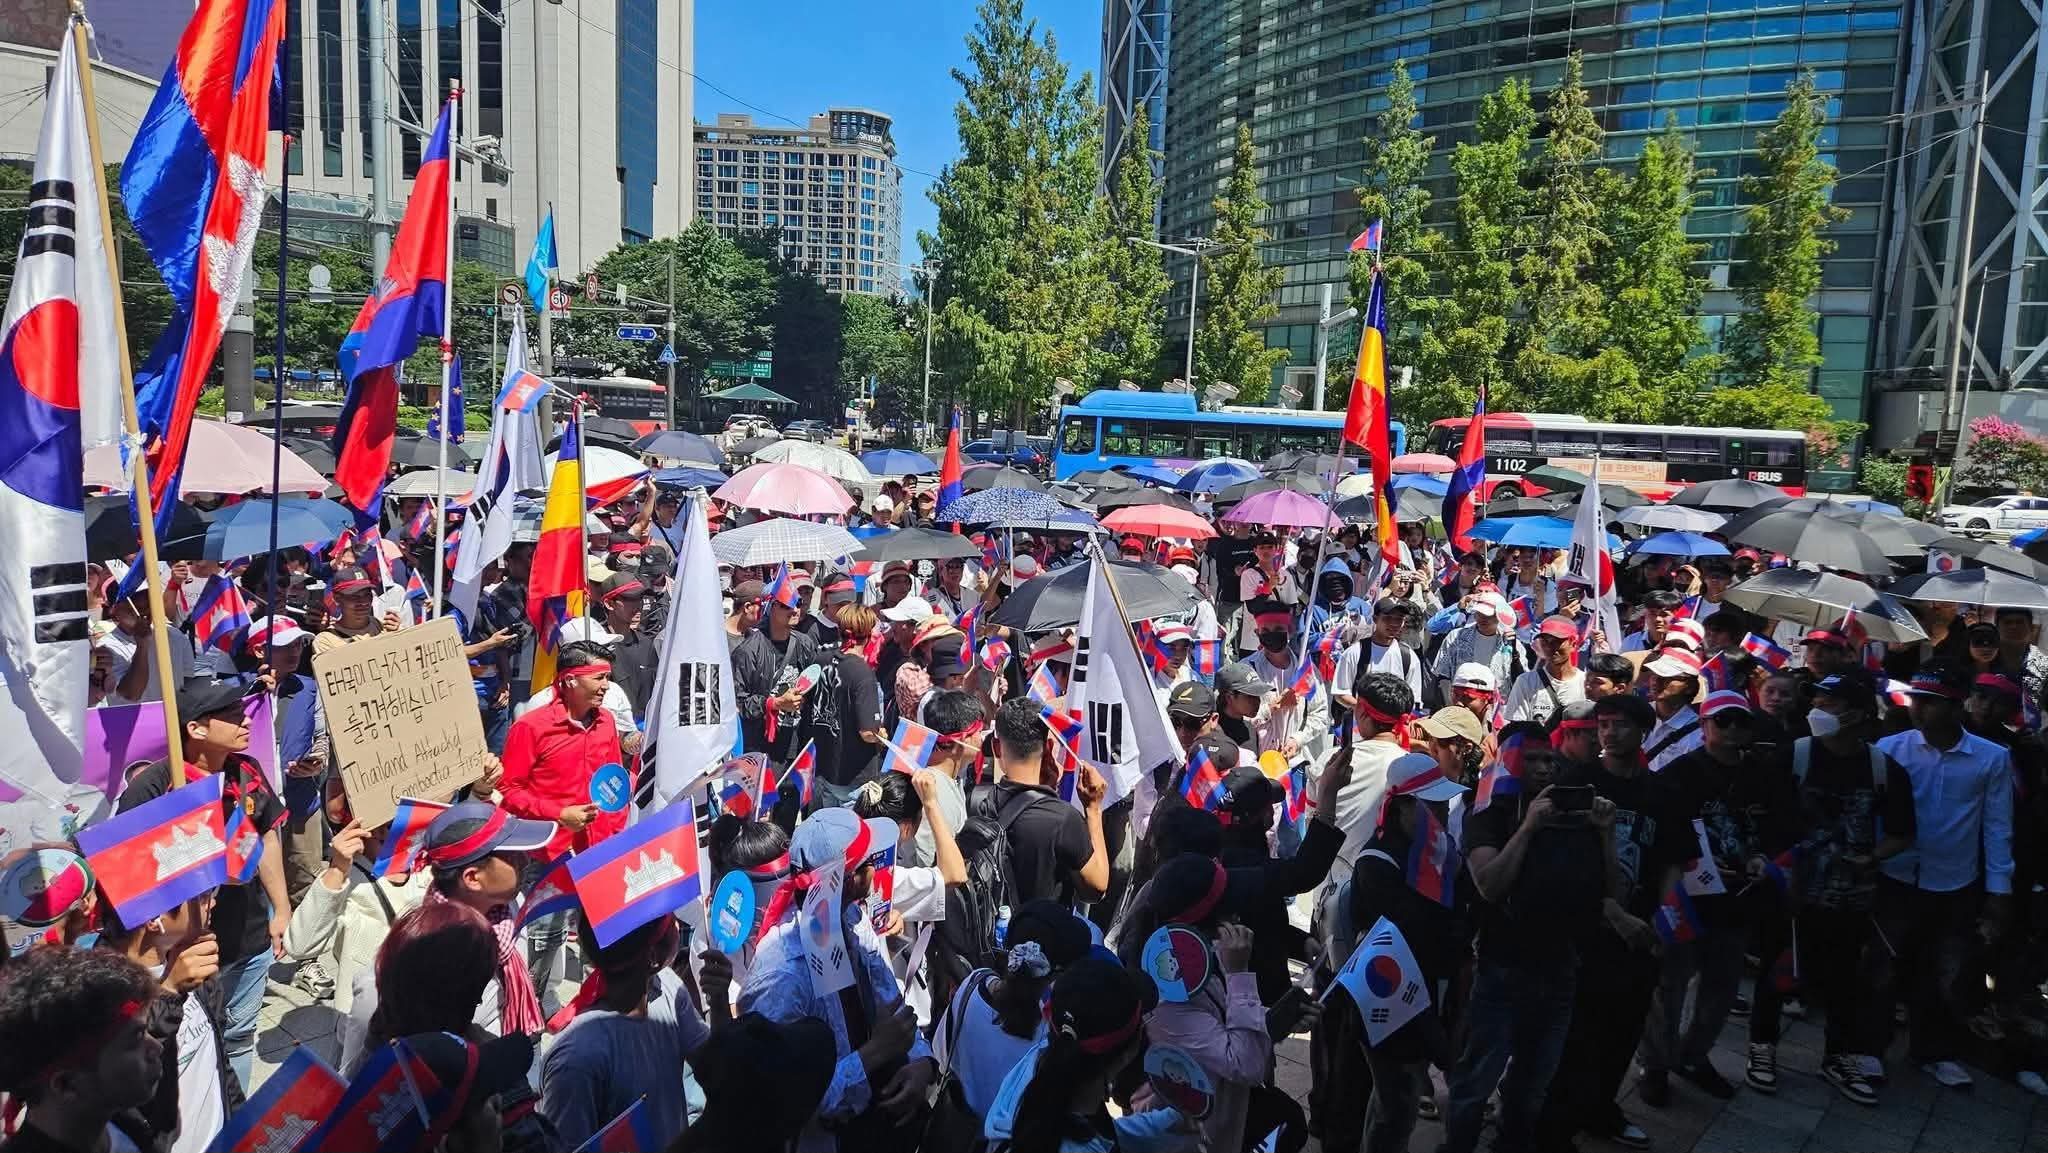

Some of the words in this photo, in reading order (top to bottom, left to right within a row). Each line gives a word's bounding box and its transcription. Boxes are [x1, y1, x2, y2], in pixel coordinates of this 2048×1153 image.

[1496, 458, 1527, 471] 1102
[325, 663, 366, 696] 태국이
[343, 741, 408, 792] Thailand
